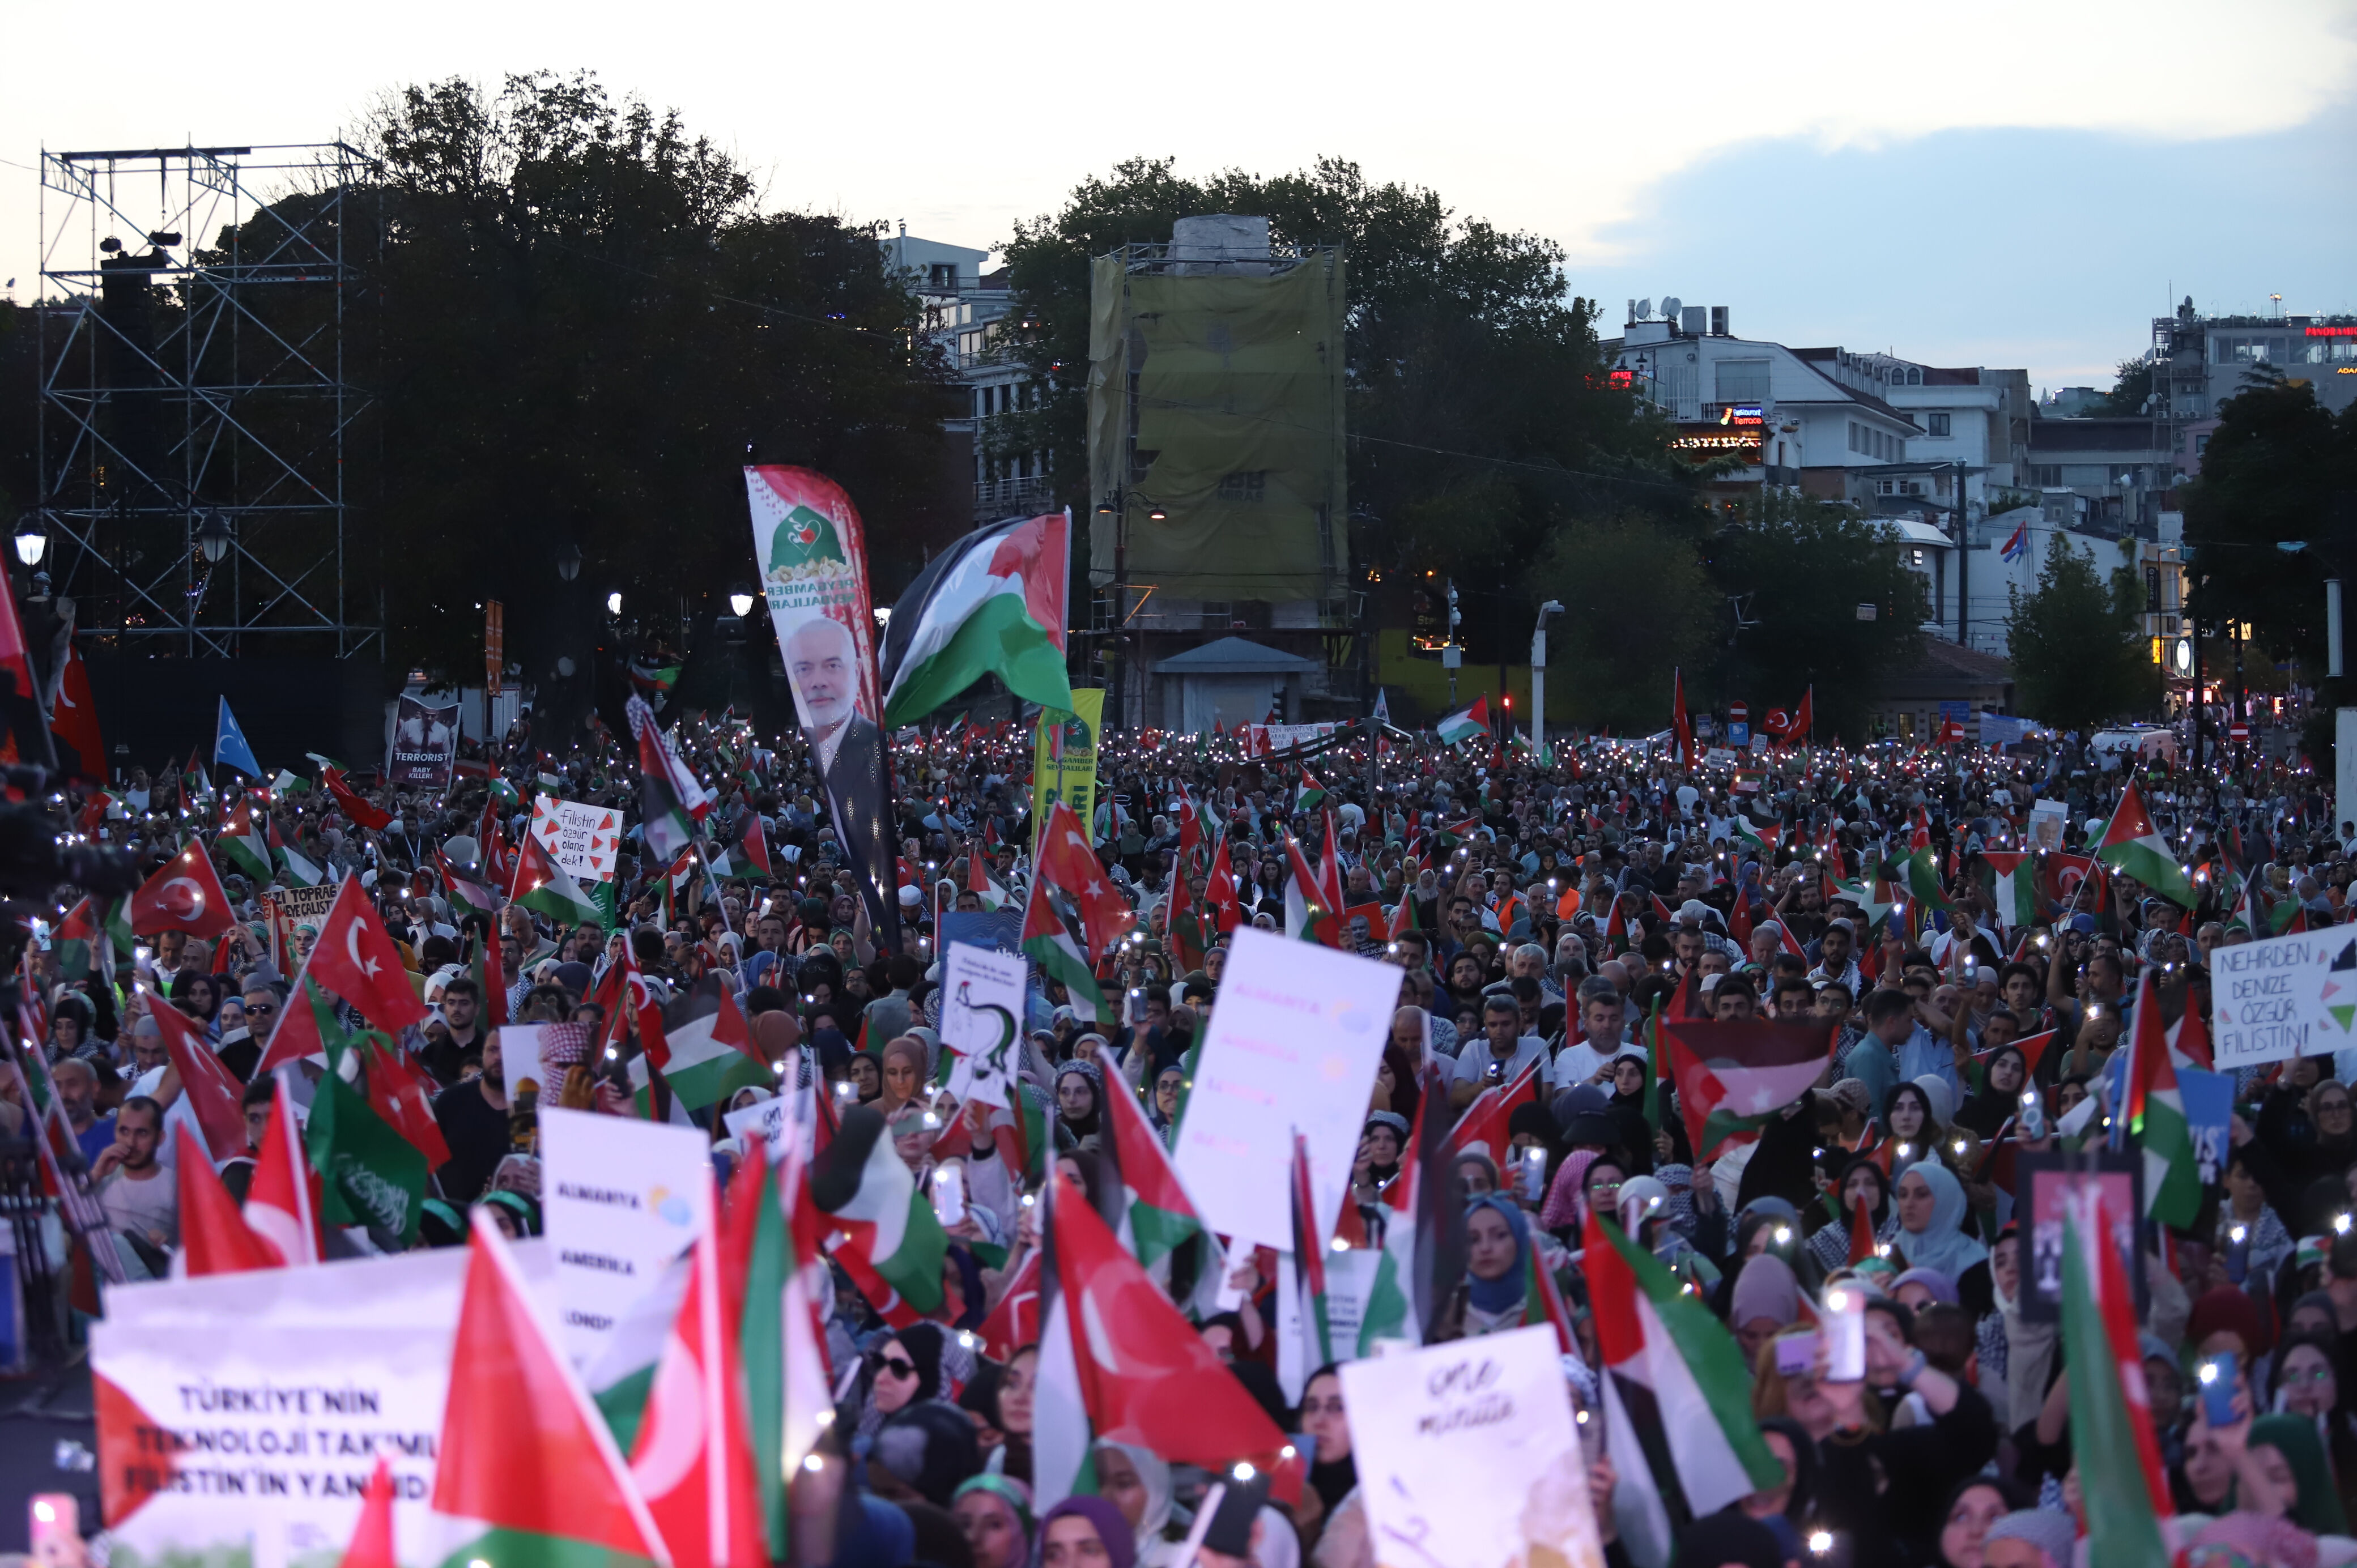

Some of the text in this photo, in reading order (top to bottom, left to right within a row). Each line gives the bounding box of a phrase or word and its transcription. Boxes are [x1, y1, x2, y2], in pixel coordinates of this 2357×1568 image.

[396, 752, 449, 762] TERRORIST
[560, 809, 595, 829] Filistin
[562, 841, 585, 852] olana
[561, 854, 584, 867] dek!
[2220, 941, 2311, 974] NEHİRDEN
[2240, 998, 2298, 1025] ÖZGÜR
[559, 1182, 641, 1209] ALMANYA
[179, 1380, 380, 1414] TÜRKİYE'NİN
[135, 1424, 307, 1455] TEKNOLOJİ
